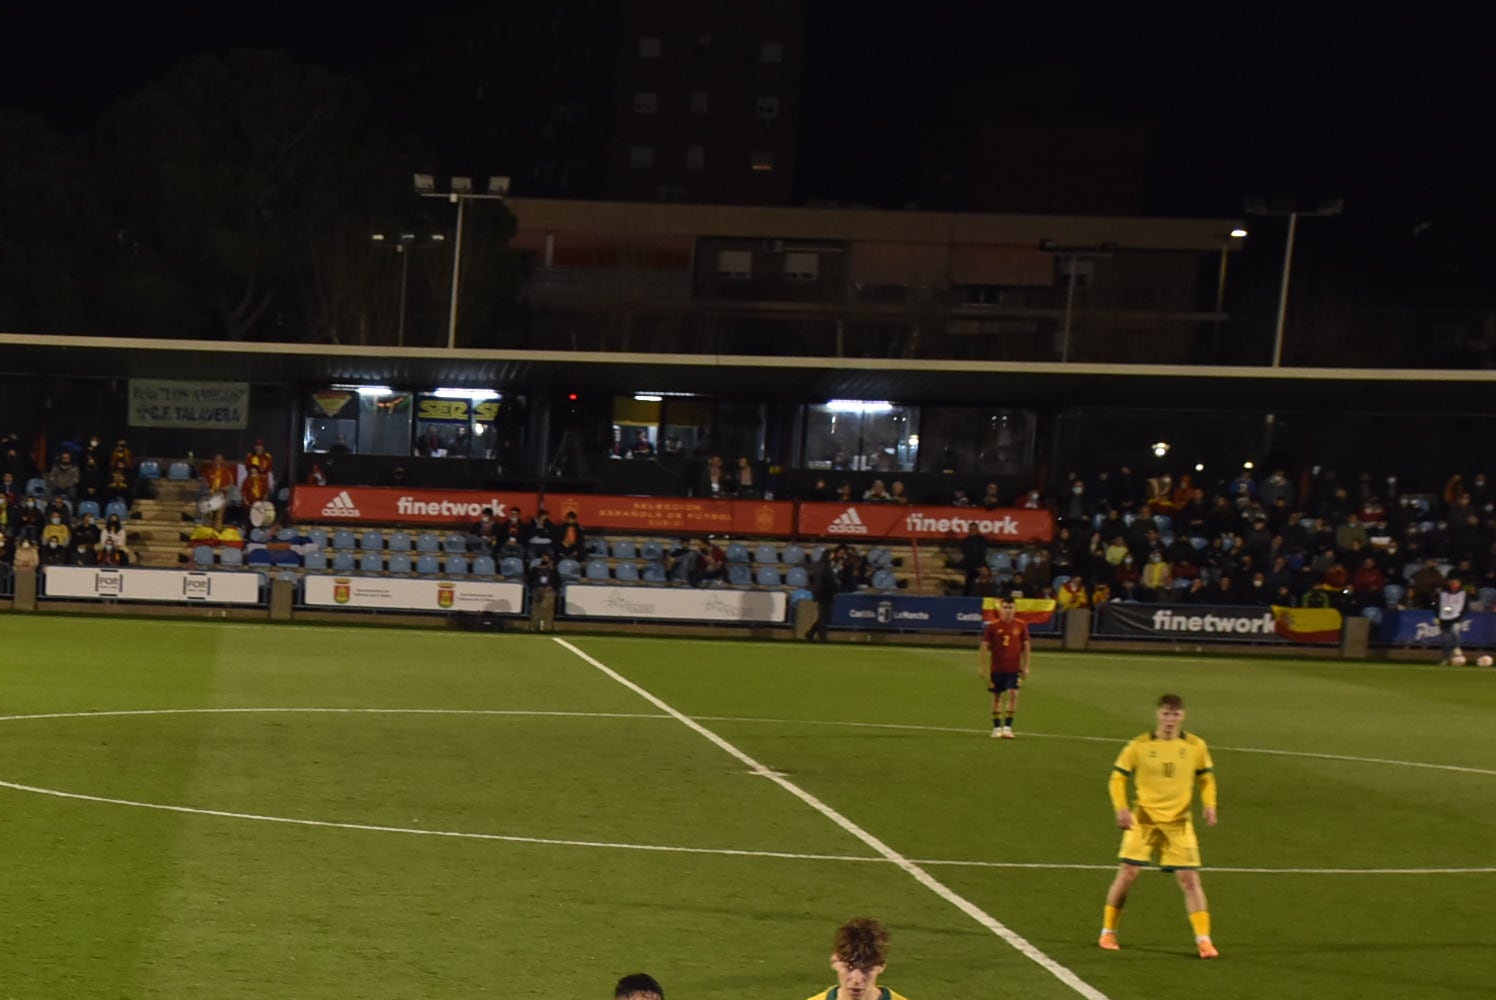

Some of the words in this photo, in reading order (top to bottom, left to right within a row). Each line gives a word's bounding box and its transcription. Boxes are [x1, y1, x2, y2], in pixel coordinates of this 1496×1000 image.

[417, 400, 470, 420] SER
[321, 507, 361, 518] adidas
[397, 497, 506, 517] finetwork
[827, 523, 868, 535] adidas
[1152, 609, 1276, 635] finetwork
